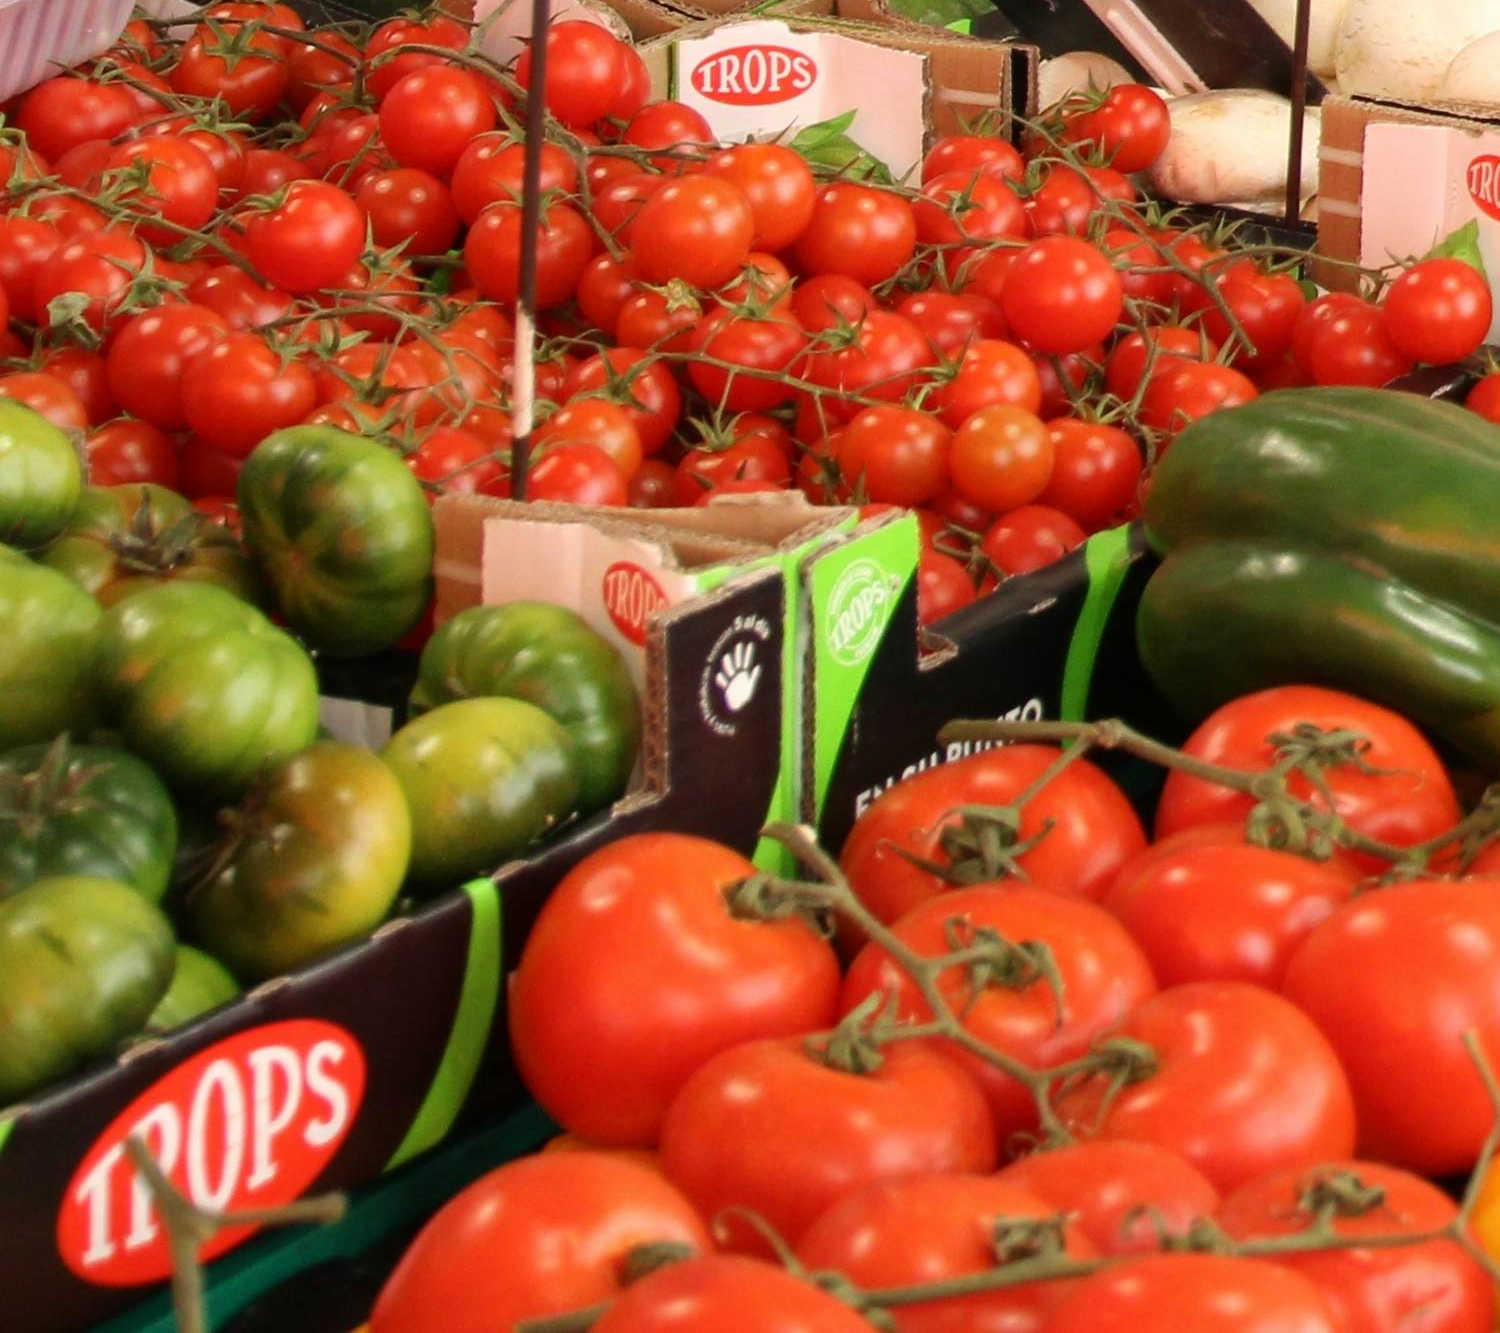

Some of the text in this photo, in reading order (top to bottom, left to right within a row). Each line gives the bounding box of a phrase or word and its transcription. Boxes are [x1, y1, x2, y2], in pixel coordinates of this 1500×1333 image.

[698, 49, 812, 95] TROPS
[832, 580, 888, 652] TROPS
[76, 1038, 351, 1267] TROPS
